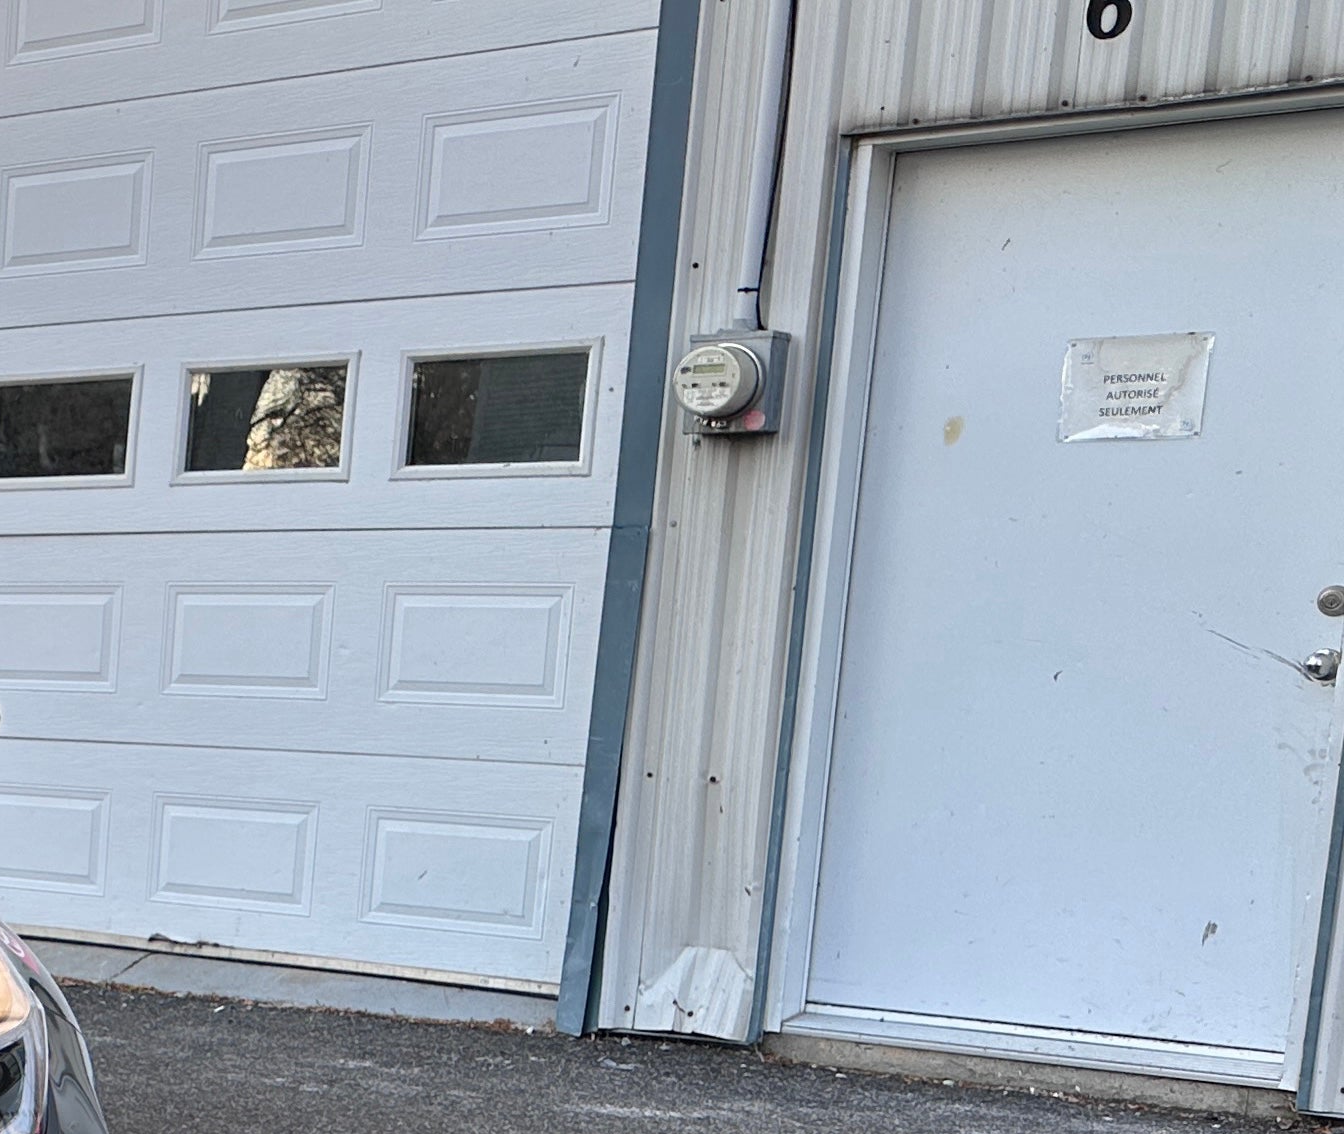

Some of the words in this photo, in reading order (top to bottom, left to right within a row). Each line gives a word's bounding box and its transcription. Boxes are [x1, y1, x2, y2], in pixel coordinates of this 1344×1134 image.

[1103, 372, 1167, 384] PERSONNEL
[1106, 387, 1159, 400] AUTORISÉ
[1098, 405, 1163, 417] SEULEMENT
